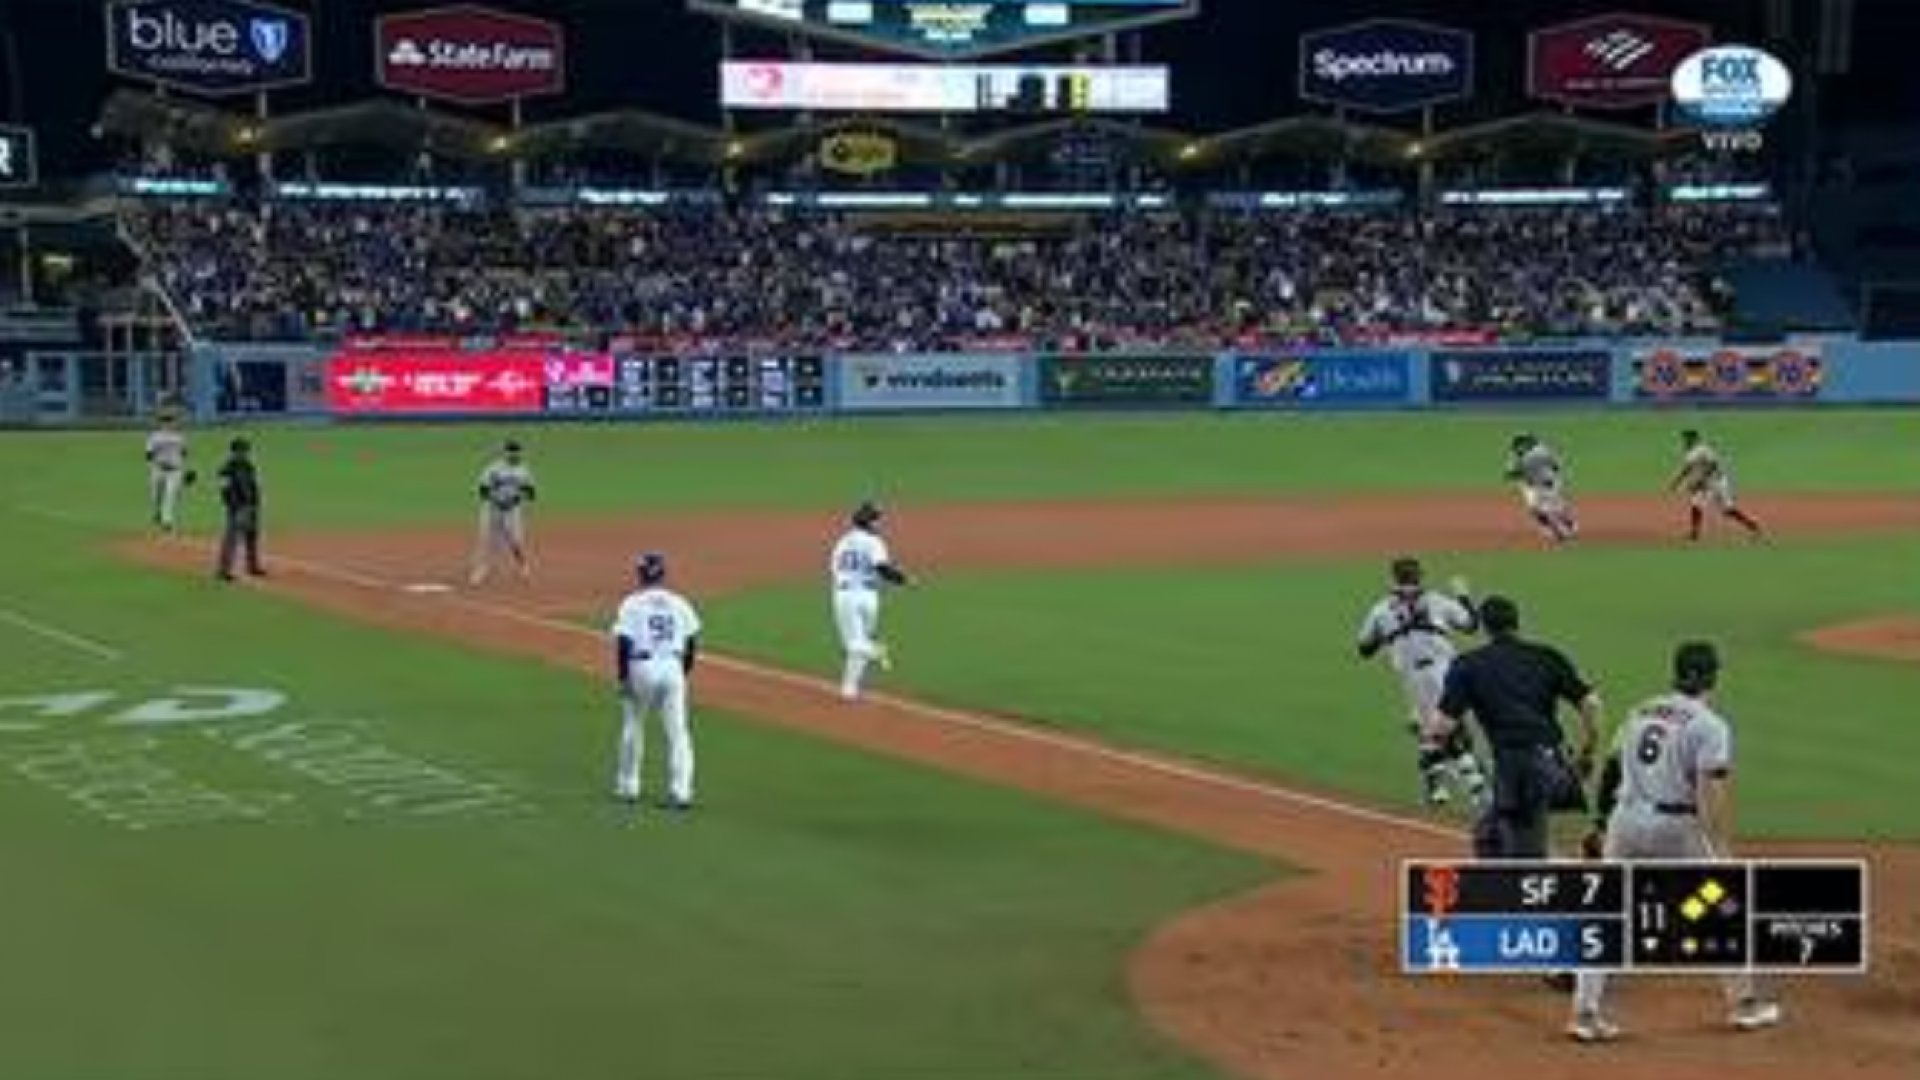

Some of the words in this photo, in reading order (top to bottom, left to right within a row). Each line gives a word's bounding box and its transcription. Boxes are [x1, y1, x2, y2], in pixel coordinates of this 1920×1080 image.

[129, 7, 237, 54] blue
[1313, 49, 1455, 84] Spectrum
[1638, 723, 1667, 765] 6
